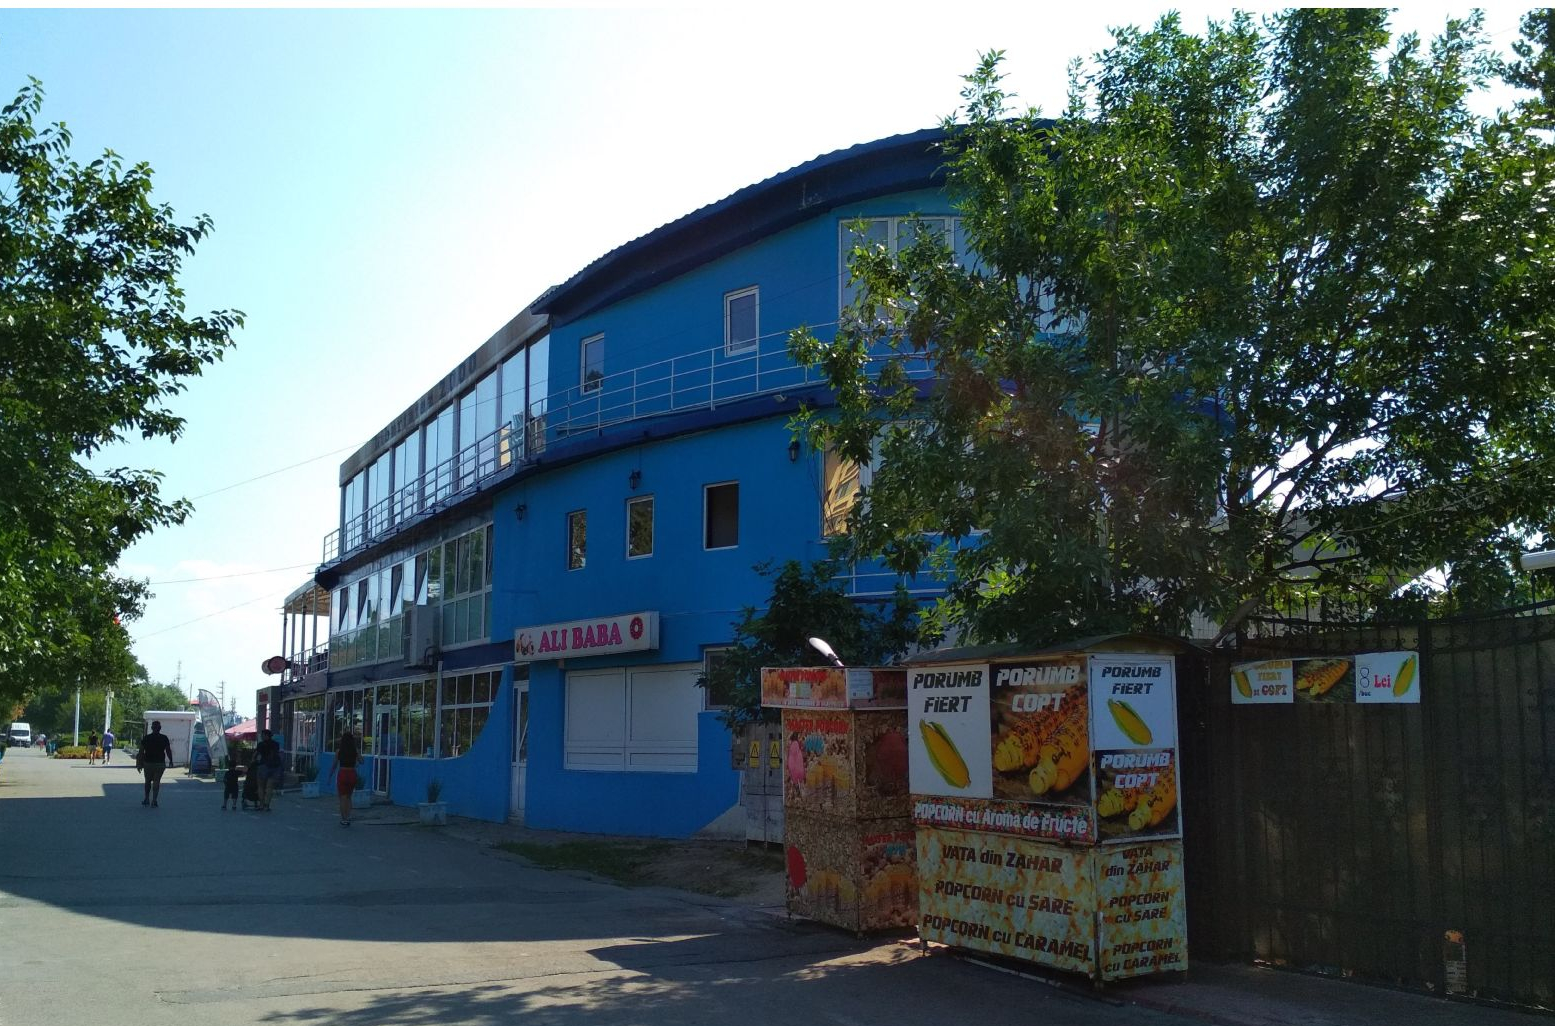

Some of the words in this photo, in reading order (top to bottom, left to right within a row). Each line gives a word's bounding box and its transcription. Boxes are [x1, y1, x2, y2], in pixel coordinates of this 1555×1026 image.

[538, 630, 567, 652] ALI
[572, 622, 623, 649] BABA
[913, 670, 982, 689] PORUMB
[996, 665, 1081, 687] PORUMB
[1101, 667, 1161, 678] PORUMB
[1360, 667, 1370, 689] 8
[1374, 674, 1392, 688] Lei
[1111, 683, 1153, 695] FIERT
[924, 696, 972, 713] FIERT
[1011, 693, 1066, 713] COPT
[1100, 753, 1171, 770] PORUMB
[1114, 773, 1160, 789] COPT
[914, 802, 964, 822] POPCORN
[965, 810, 980, 824] cu
[982, 807, 1021, 827] Aroma
[1022, 812, 1040, 829] de
[1041, 814, 1087, 835] Fructe
[943, 845, 977, 861] VATA
[980, 850, 1002, 867] din
[1005, 852, 1063, 873] ZAHAR
[1123, 846, 1153, 860] VATA
[1105, 865, 1123, 877] din
[1127, 860, 1169, 875] ZAHAR
[935, 880, 1004, 905] POPCORN
[1006, 892, 1025, 909] cu
[1029, 894, 1073, 916] SARE
[1110, 891, 1169, 909] POPCORN
[1115, 912, 1131, 925] cu
[1134, 907, 1167, 922] SARE
[923, 914, 991, 941] POPCORN
[992, 928, 1012, 946] cu
[1015, 931, 1094, 963] CARAMEL
[1113, 937, 1172, 957] POPCORN
[1104, 961, 1121, 973] cu
[1123, 953, 1180, 971] CARAMEL
